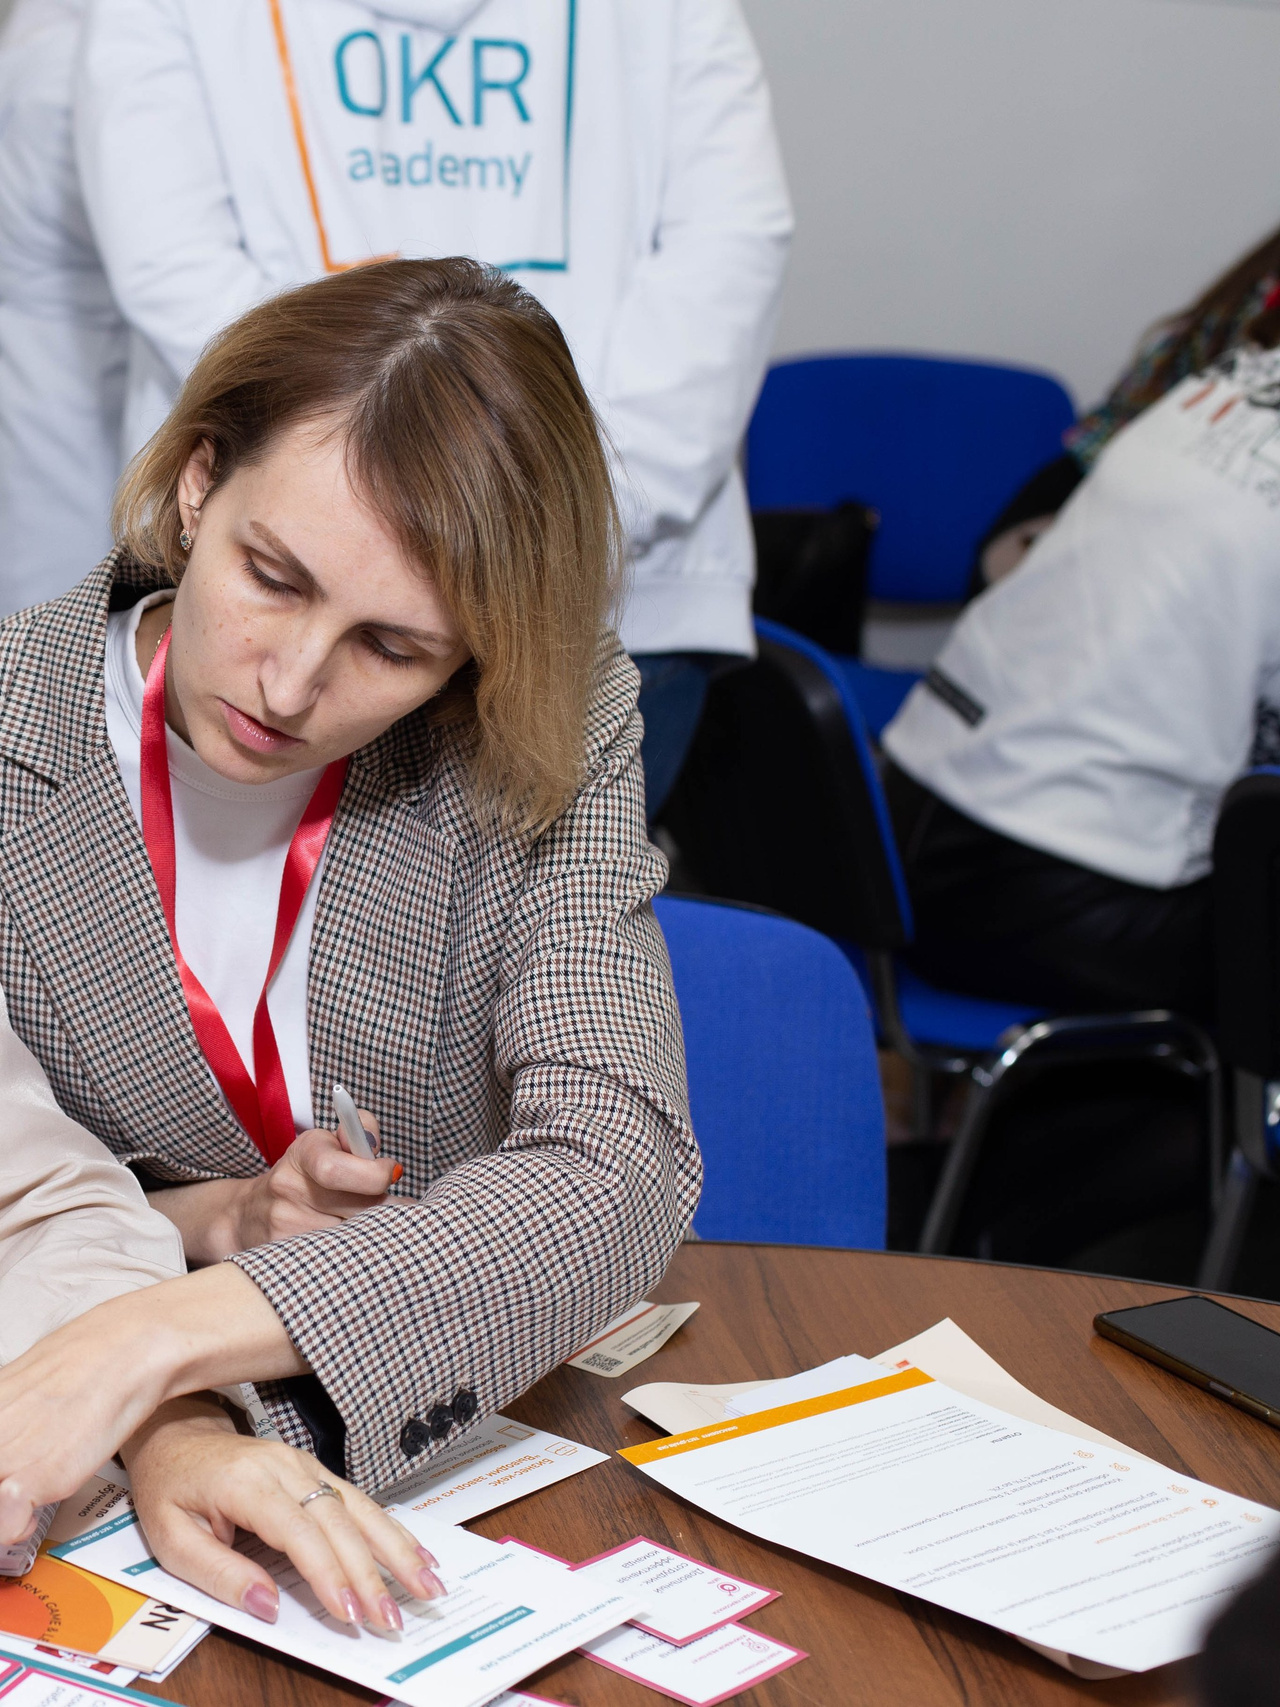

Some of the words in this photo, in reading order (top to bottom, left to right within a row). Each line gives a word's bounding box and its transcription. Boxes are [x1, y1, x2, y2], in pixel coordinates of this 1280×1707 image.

[333, 29, 532, 127] OKR
[991, 1432, 1022, 1443] Отделы
[474, 1444, 506, 1458] Фабрика
[451, 1458, 474, 1468] «Ваши
[489, 1458, 553, 1486] Бизнес-кейс
[1048, 1466, 1086, 1480] Ключевой
[454, 1476, 487, 1490] завод
[1010, 1478, 1047, 1494] результат
[1083, 1478, 1122, 1492] Ключевой
[78, 1483, 116, 1517] обучению
[954, 1494, 1004, 1512] Рекламации
[1047, 1490, 1083, 1506] результат
[1132, 1497, 1170, 1512] Ключевой
[96, 1508, 109, 1518] по
[1067, 1510, 1106, 1525] сокращен
[1095, 1510, 1131, 1525] результат
[855, 1530, 900, 1547] клиентами
[1056, 1527, 1089, 1540] Полный
[496, 1553, 515, 1562] Цель
[622, 1550, 659, 1568] команда
[618, 1557, 674, 1583] эффективная
[646, 1563, 688, 1584] сотрудник
[654, 1568, 704, 1593] Довольный
[740, 1591, 756, 1601] ОТДЕЛ
[588, 1596, 623, 1614] Чек-лист
[713, 1600, 741, 1614] ПЕРСОНАЛА
[45, 1602, 62, 1626] GAME
[572, 1613, 587, 1622] для
[534, 1622, 571, 1642] проверки
[497, 1642, 532, 1661] качества
